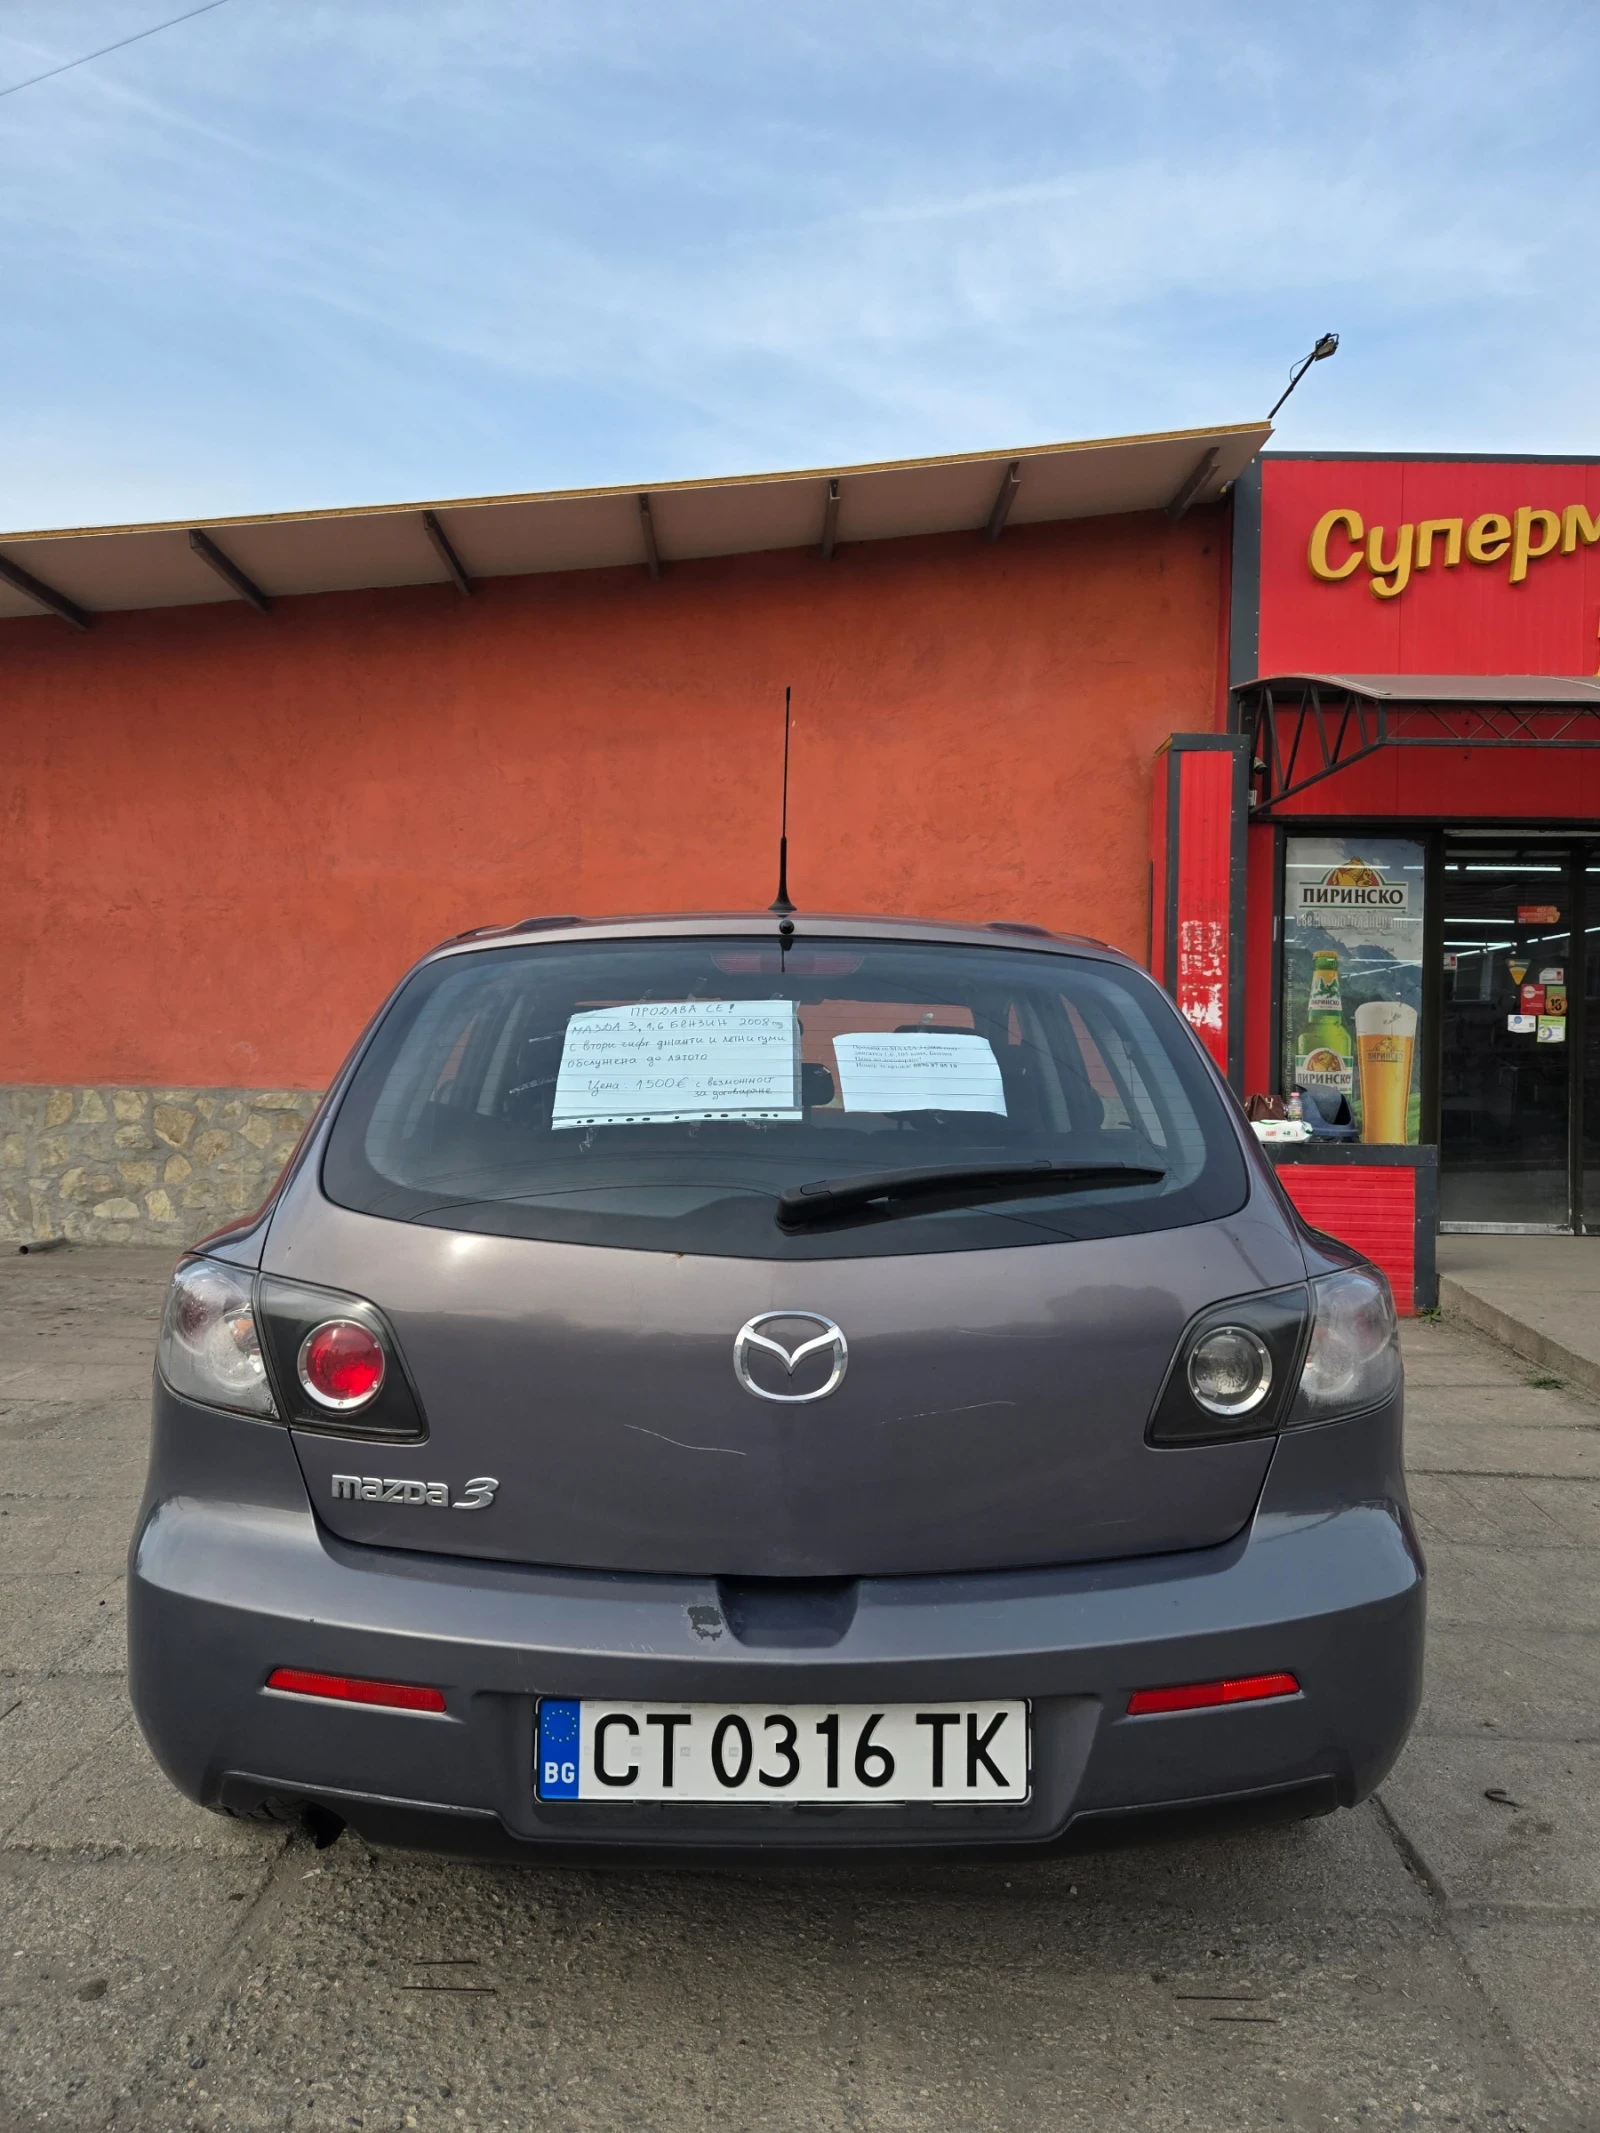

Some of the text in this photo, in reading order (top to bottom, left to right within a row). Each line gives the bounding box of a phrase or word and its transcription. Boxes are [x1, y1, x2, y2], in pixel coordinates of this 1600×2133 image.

[1302, 888, 1404, 905] ПИРИНСКО
[630, 1004, 697, 1017] ПРОДАВА
[571, 1021, 621, 1034] МАЗДА
[739, 1017, 770, 1028] 2008
[583, 1040, 617, 1052] втори
[656, 1037, 705, 1052] джанти
[646, 1055, 662, 1068] до
[667, 1052, 708, 1062] лятото
[1368, 1052, 1403, 1060] ПИРИНСКО
[636, 1076, 690, 1091] 1500€
[692, 1090, 707, 1099] за
[453, 1477, 500, 1510] 3
[593, 1711, 1010, 1788] CT 0316 TK
[543, 1761, 576, 1785] BG
